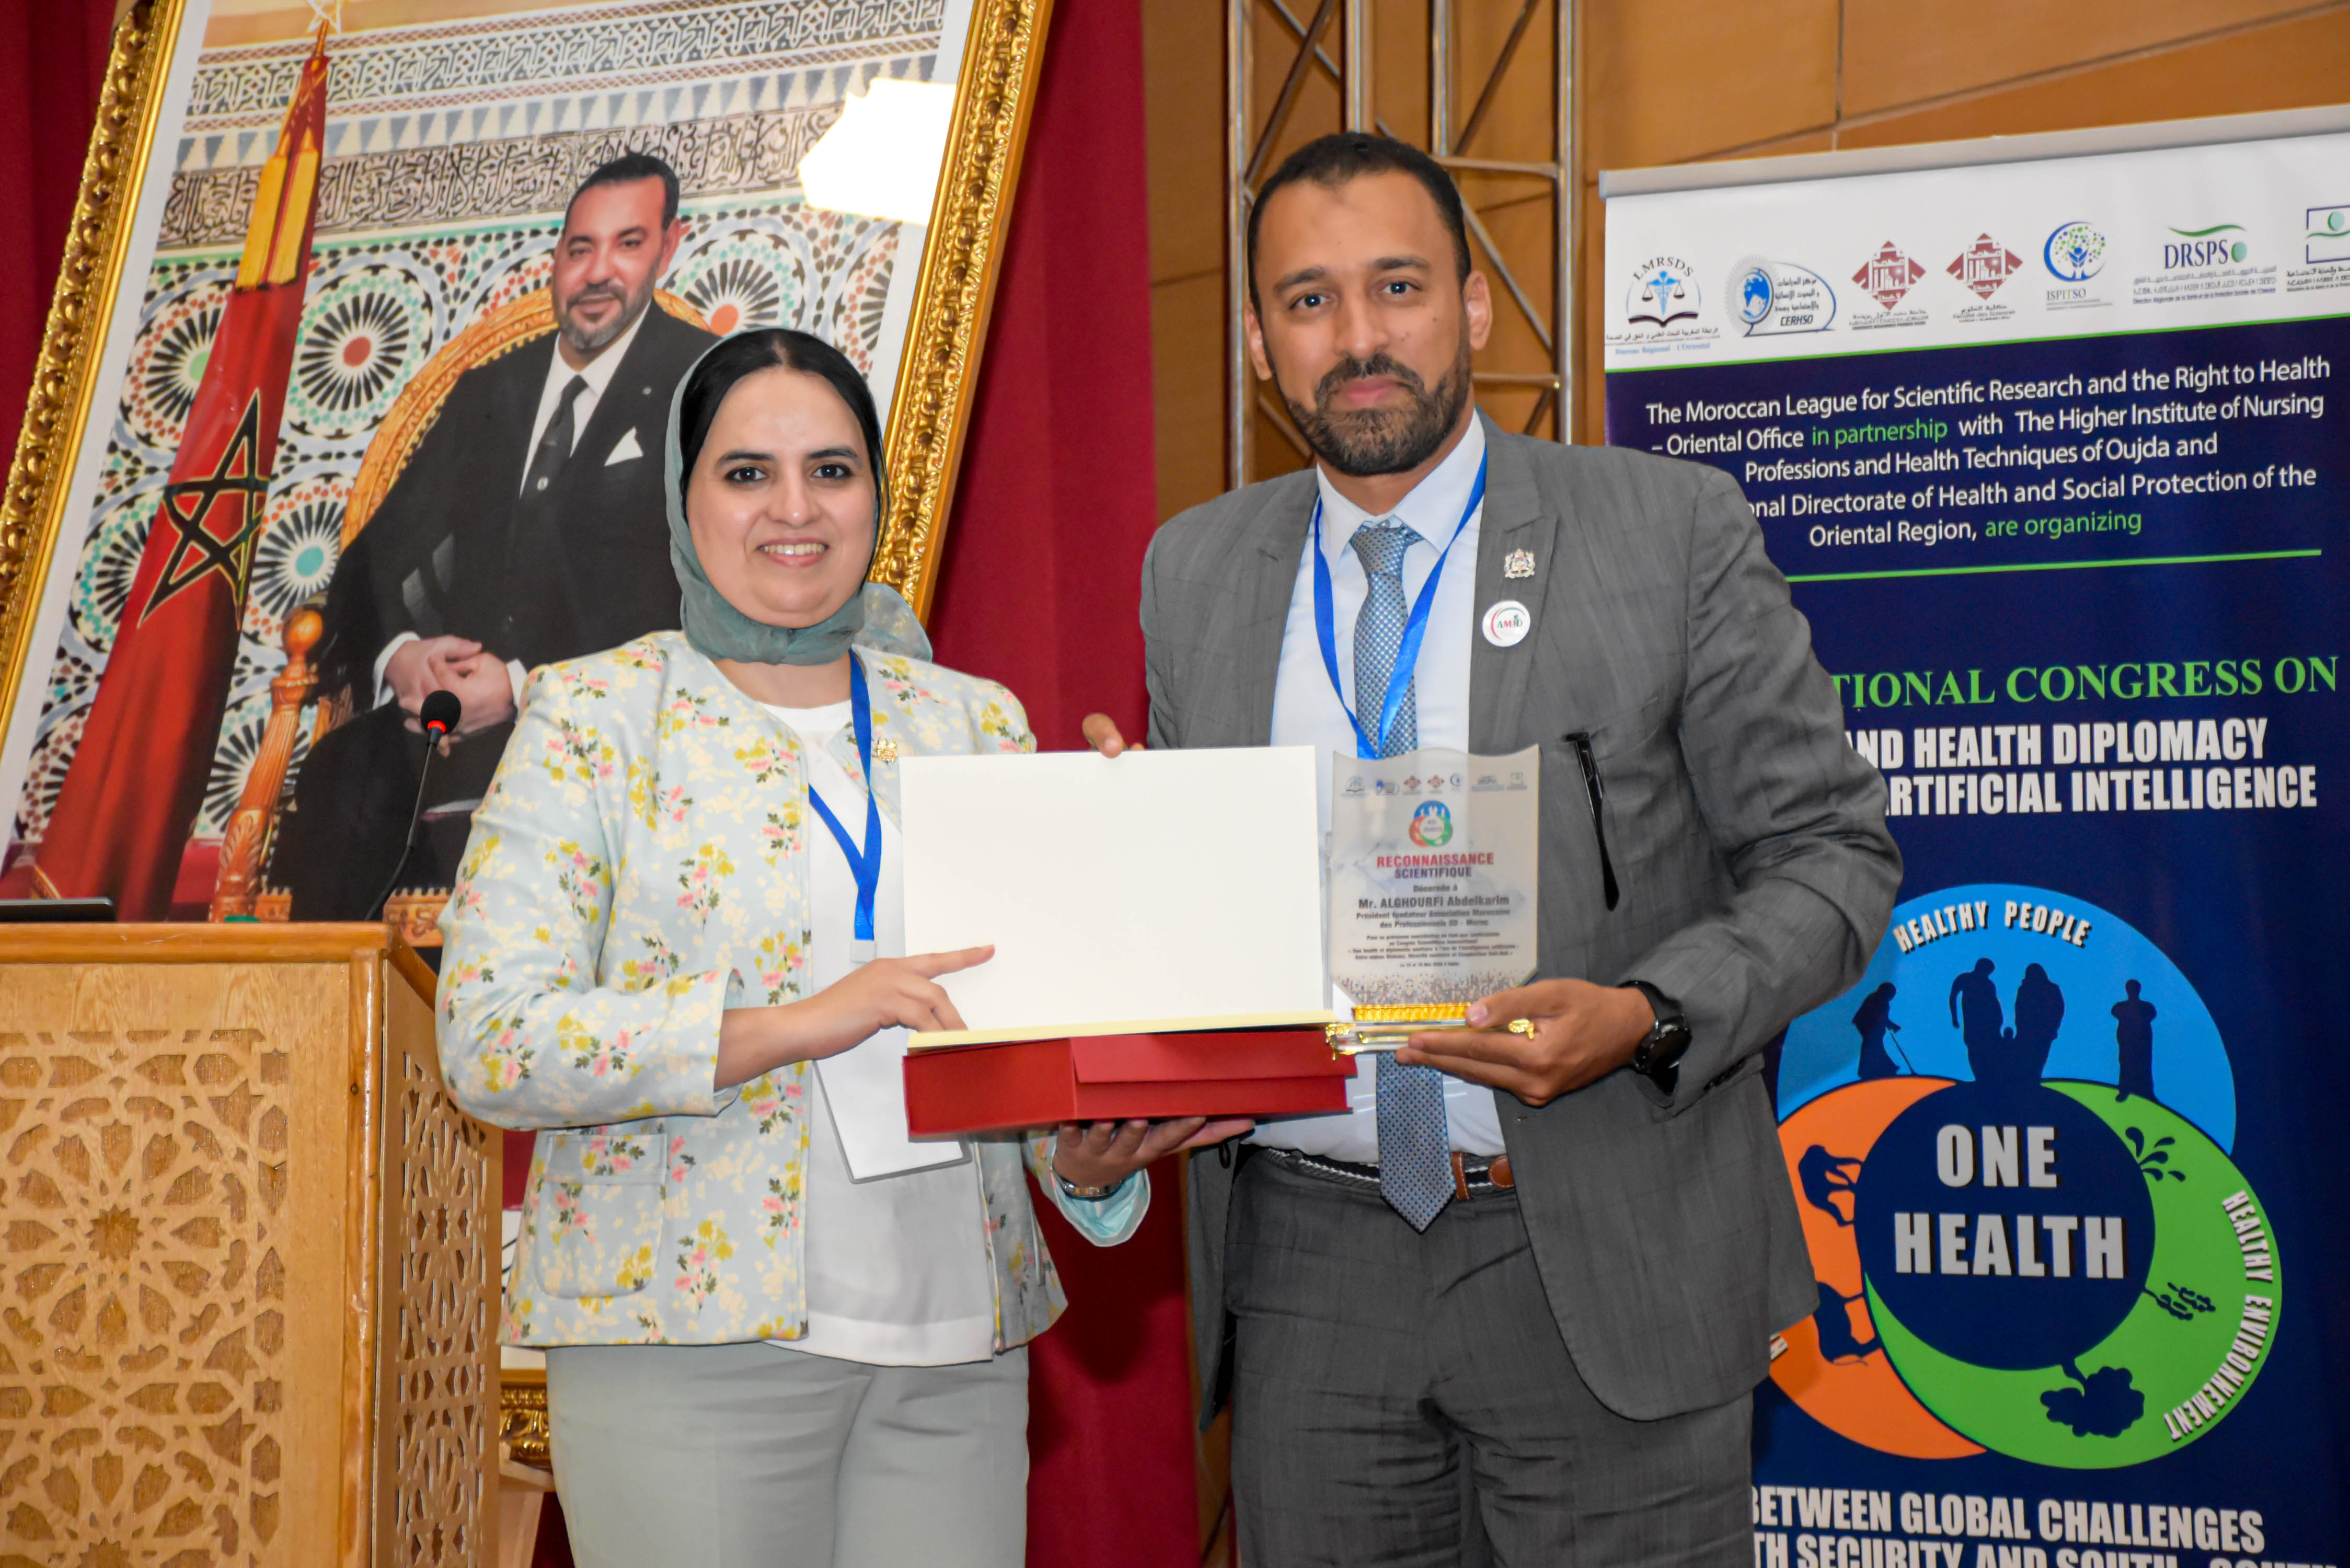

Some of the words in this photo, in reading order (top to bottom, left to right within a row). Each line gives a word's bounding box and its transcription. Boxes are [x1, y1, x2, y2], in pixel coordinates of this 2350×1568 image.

[1633, 257, 1694, 281] LMRSDS
[2163, 239, 2229, 270] DRSPS
[2046, 288, 2087, 301] ISPITSO
[1780, 315, 1813, 326] CERHSO
[1646, 403, 1681, 424] The
[1686, 401, 1780, 422] Moroccan
[1787, 395, 1857, 418] League
[1862, 388, 1890, 410] for
[1894, 381, 1984, 408] Scientific
[1990, 374, 2082, 401] Research
[2088, 370, 2126, 394] and
[2133, 369, 2169, 391] the
[2176, 364, 2229, 393] Right
[2233, 365, 2254, 384] to
[2261, 355, 2330, 382] Health
[1667, 430, 1741, 455] Oriental
[1747, 427, 1804, 449] Office
[1813, 426, 1829, 445] in
[1835, 418, 1947, 449] partnership
[1959, 413, 2002, 436] with
[2015, 410, 2054, 432] The
[2060, 406, 2127, 434] Higher
[2132, 402, 2217, 424] Institute
[2221, 396, 2241, 419] of
[2244, 393, 2323, 418] Nursing
[1746, 458, 1850, 482] Professions
[1854, 453, 1890, 476] and
[1896, 448, 1959, 472] Health
[1963, 445, 2078, 469] Techniques
[2082, 439, 2103, 462] of
[2106, 436, 2169, 464] Oujda
[2176, 432, 2217, 456] and
[1792, 491, 1906, 515] Directorate
[1912, 486, 1934, 508] of
[1940, 482, 2007, 506] Health
[2014, 479, 2055, 502] and
[2063, 475, 2124, 500] Social
[2133, 470, 2246, 495] Protection
[2253, 465, 2275, 488] of
[2279, 465, 2316, 487] the
[1810, 521, 1891, 546] Oriental
[1898, 520, 1976, 546] Region,
[1986, 521, 2018, 537] are
[2025, 510, 2141, 539] organizing
[2007, 660, 2262, 702] CONGRESS
[2275, 656, 2337, 693] ON
[1914, 725, 2041, 768] HEALTH
[2053, 719, 2267, 764] DIPLOMACY
[1886, 773, 2061, 815] RTIFICIAL
[2072, 766, 2317, 811] INTELLIGENCE
[1377, 852, 1494, 868] RECONNAISSANCE
[1395, 867, 1472, 880] SCIENTIFIQUE
[1358, 898, 1377, 908] Mr.
[1380, 897, 1443, 908] ALGHOURFI
[1447, 895, 1510, 906] Abdelkarim
[1893, 901, 1988, 955] HEALTHY
[2005, 901, 2093, 949] PEOPLE
[1937, 1124, 2056, 1187] ONE
[1895, 1213, 2123, 1278] HEALTH
[2222, 1190, 2273, 1283] HEALTHY
[2163, 1295, 2273, 1441] ENVIRONNEMENT
[1900, 1492, 2031, 1539] GLOBAL
[2038, 1499, 2265, 1554] CHALLENGES
[1797, 1535, 1963, 1568] SECURITY
